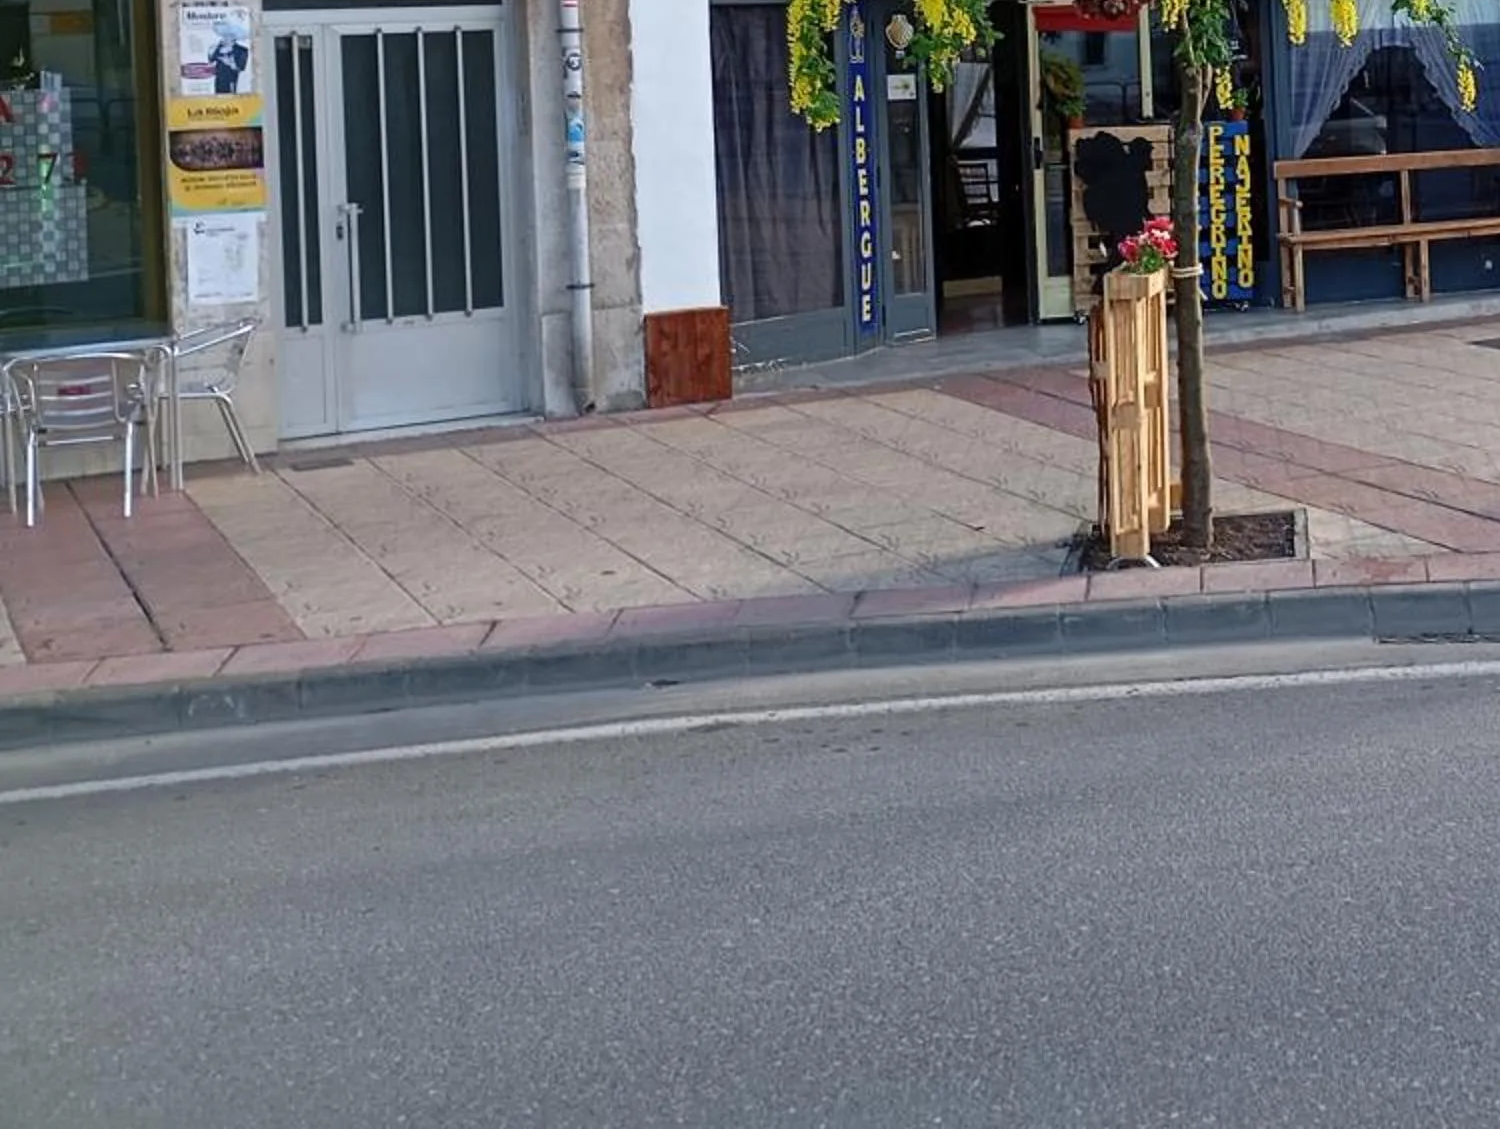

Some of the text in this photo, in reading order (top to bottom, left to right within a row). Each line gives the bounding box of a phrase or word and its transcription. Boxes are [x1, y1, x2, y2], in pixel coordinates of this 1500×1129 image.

[853, 74, 873, 322] ALBERGUE
[1208, 125, 1228, 300] PEREGRINO
[1234, 134, 1255, 289] NAJERINO
